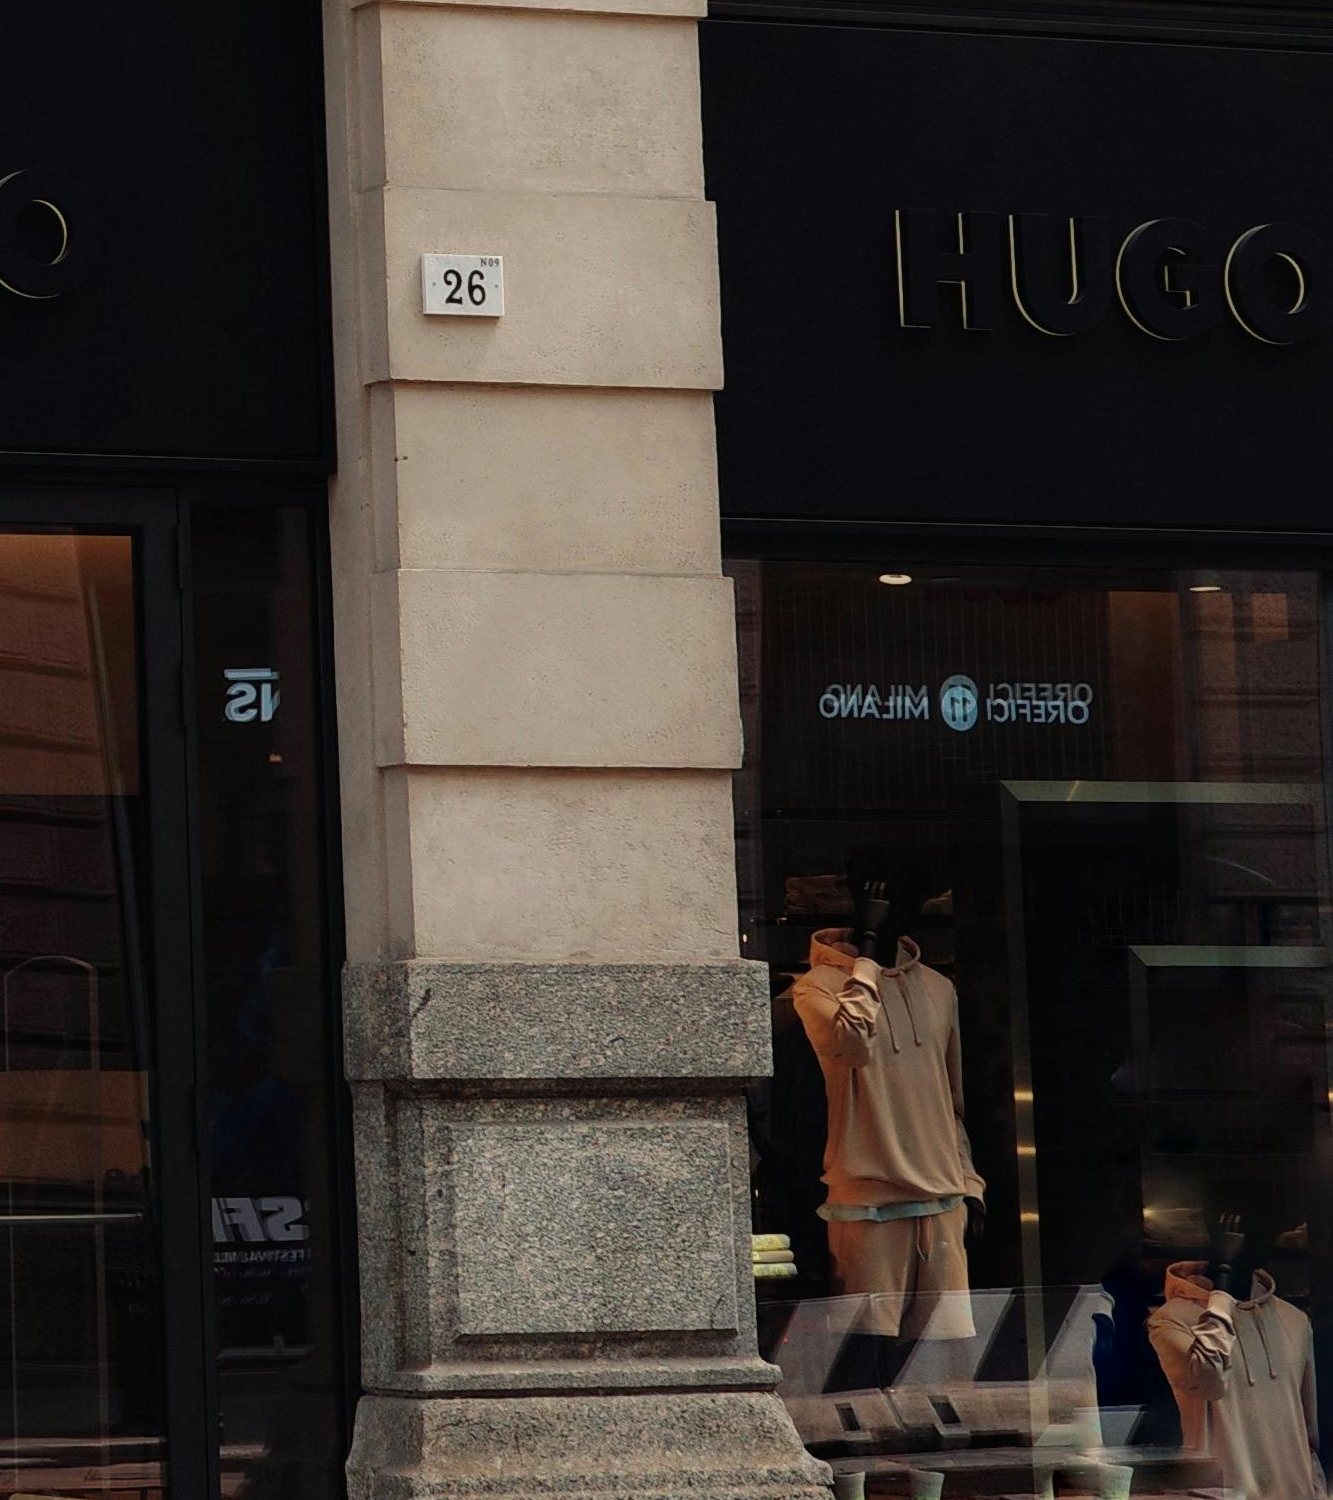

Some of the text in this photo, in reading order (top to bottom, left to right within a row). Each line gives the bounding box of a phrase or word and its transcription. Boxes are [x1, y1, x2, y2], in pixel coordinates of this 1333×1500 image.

[480, 257, 500, 267] N09
[892, 206, 1332, 346] HUGO
[443, 268, 486, 306] 26
